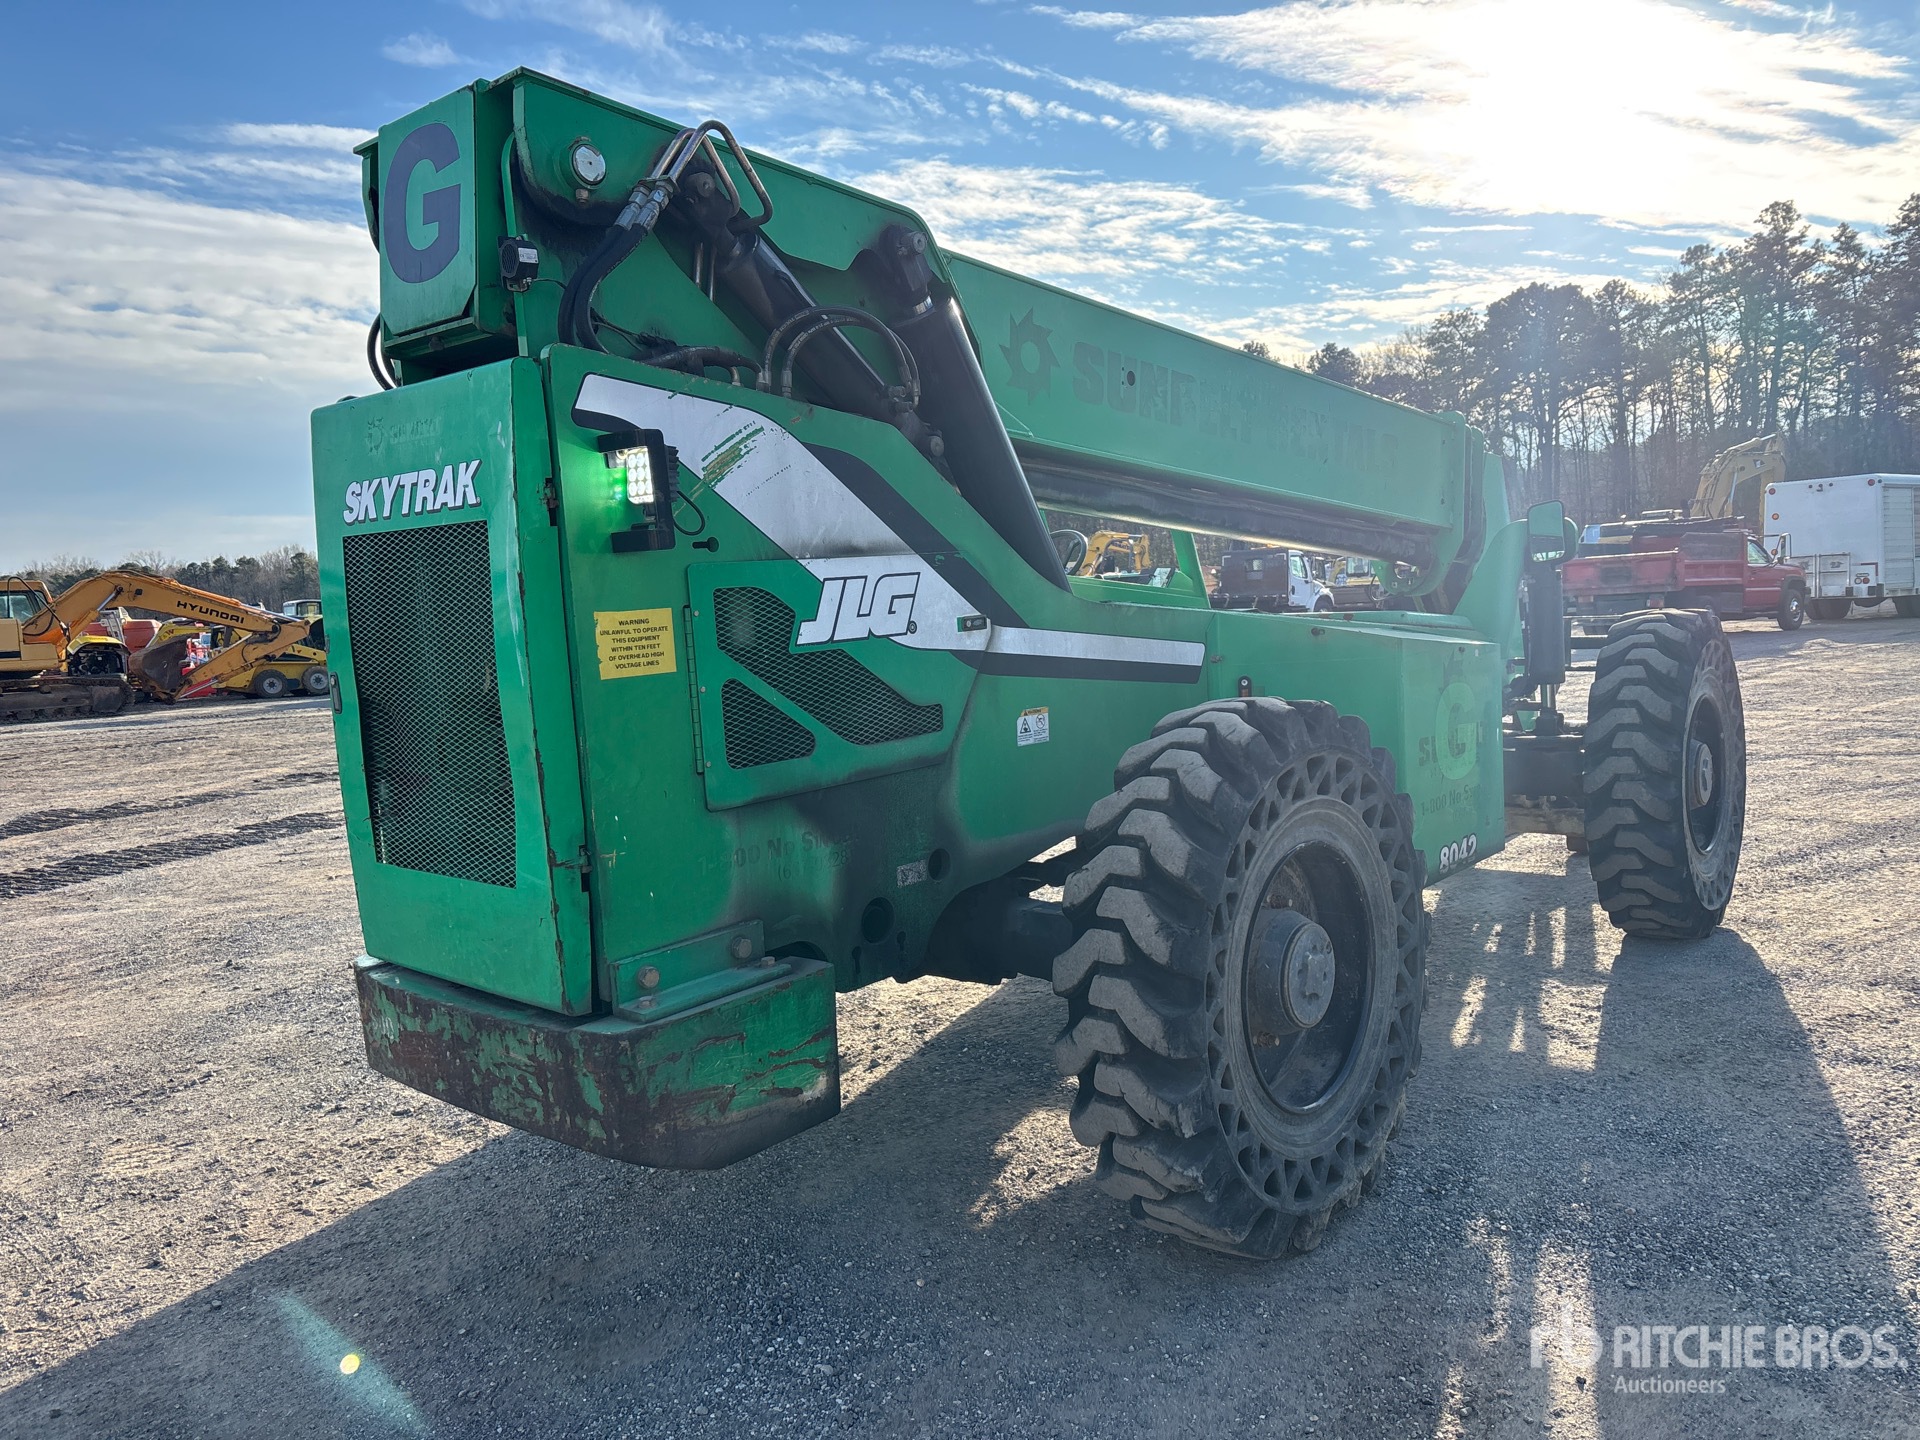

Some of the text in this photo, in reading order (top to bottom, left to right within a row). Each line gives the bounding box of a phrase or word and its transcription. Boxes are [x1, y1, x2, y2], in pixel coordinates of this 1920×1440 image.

[384, 122, 461, 284] G
[343, 459, 482, 526] SKYTRAK
[176, 600, 245, 624] HYUNDAI
[795, 572, 920, 647] JLG
[618, 618, 649, 626] WARNING
[599, 628, 632, 636] UNLAWFUL
[627, 634, 661, 643] EQUIPMENT
[615, 659, 660, 670] VOLTAGE LINES
[617, 653, 650, 661] OVERHEAD
[1435, 682, 1478, 781] G
